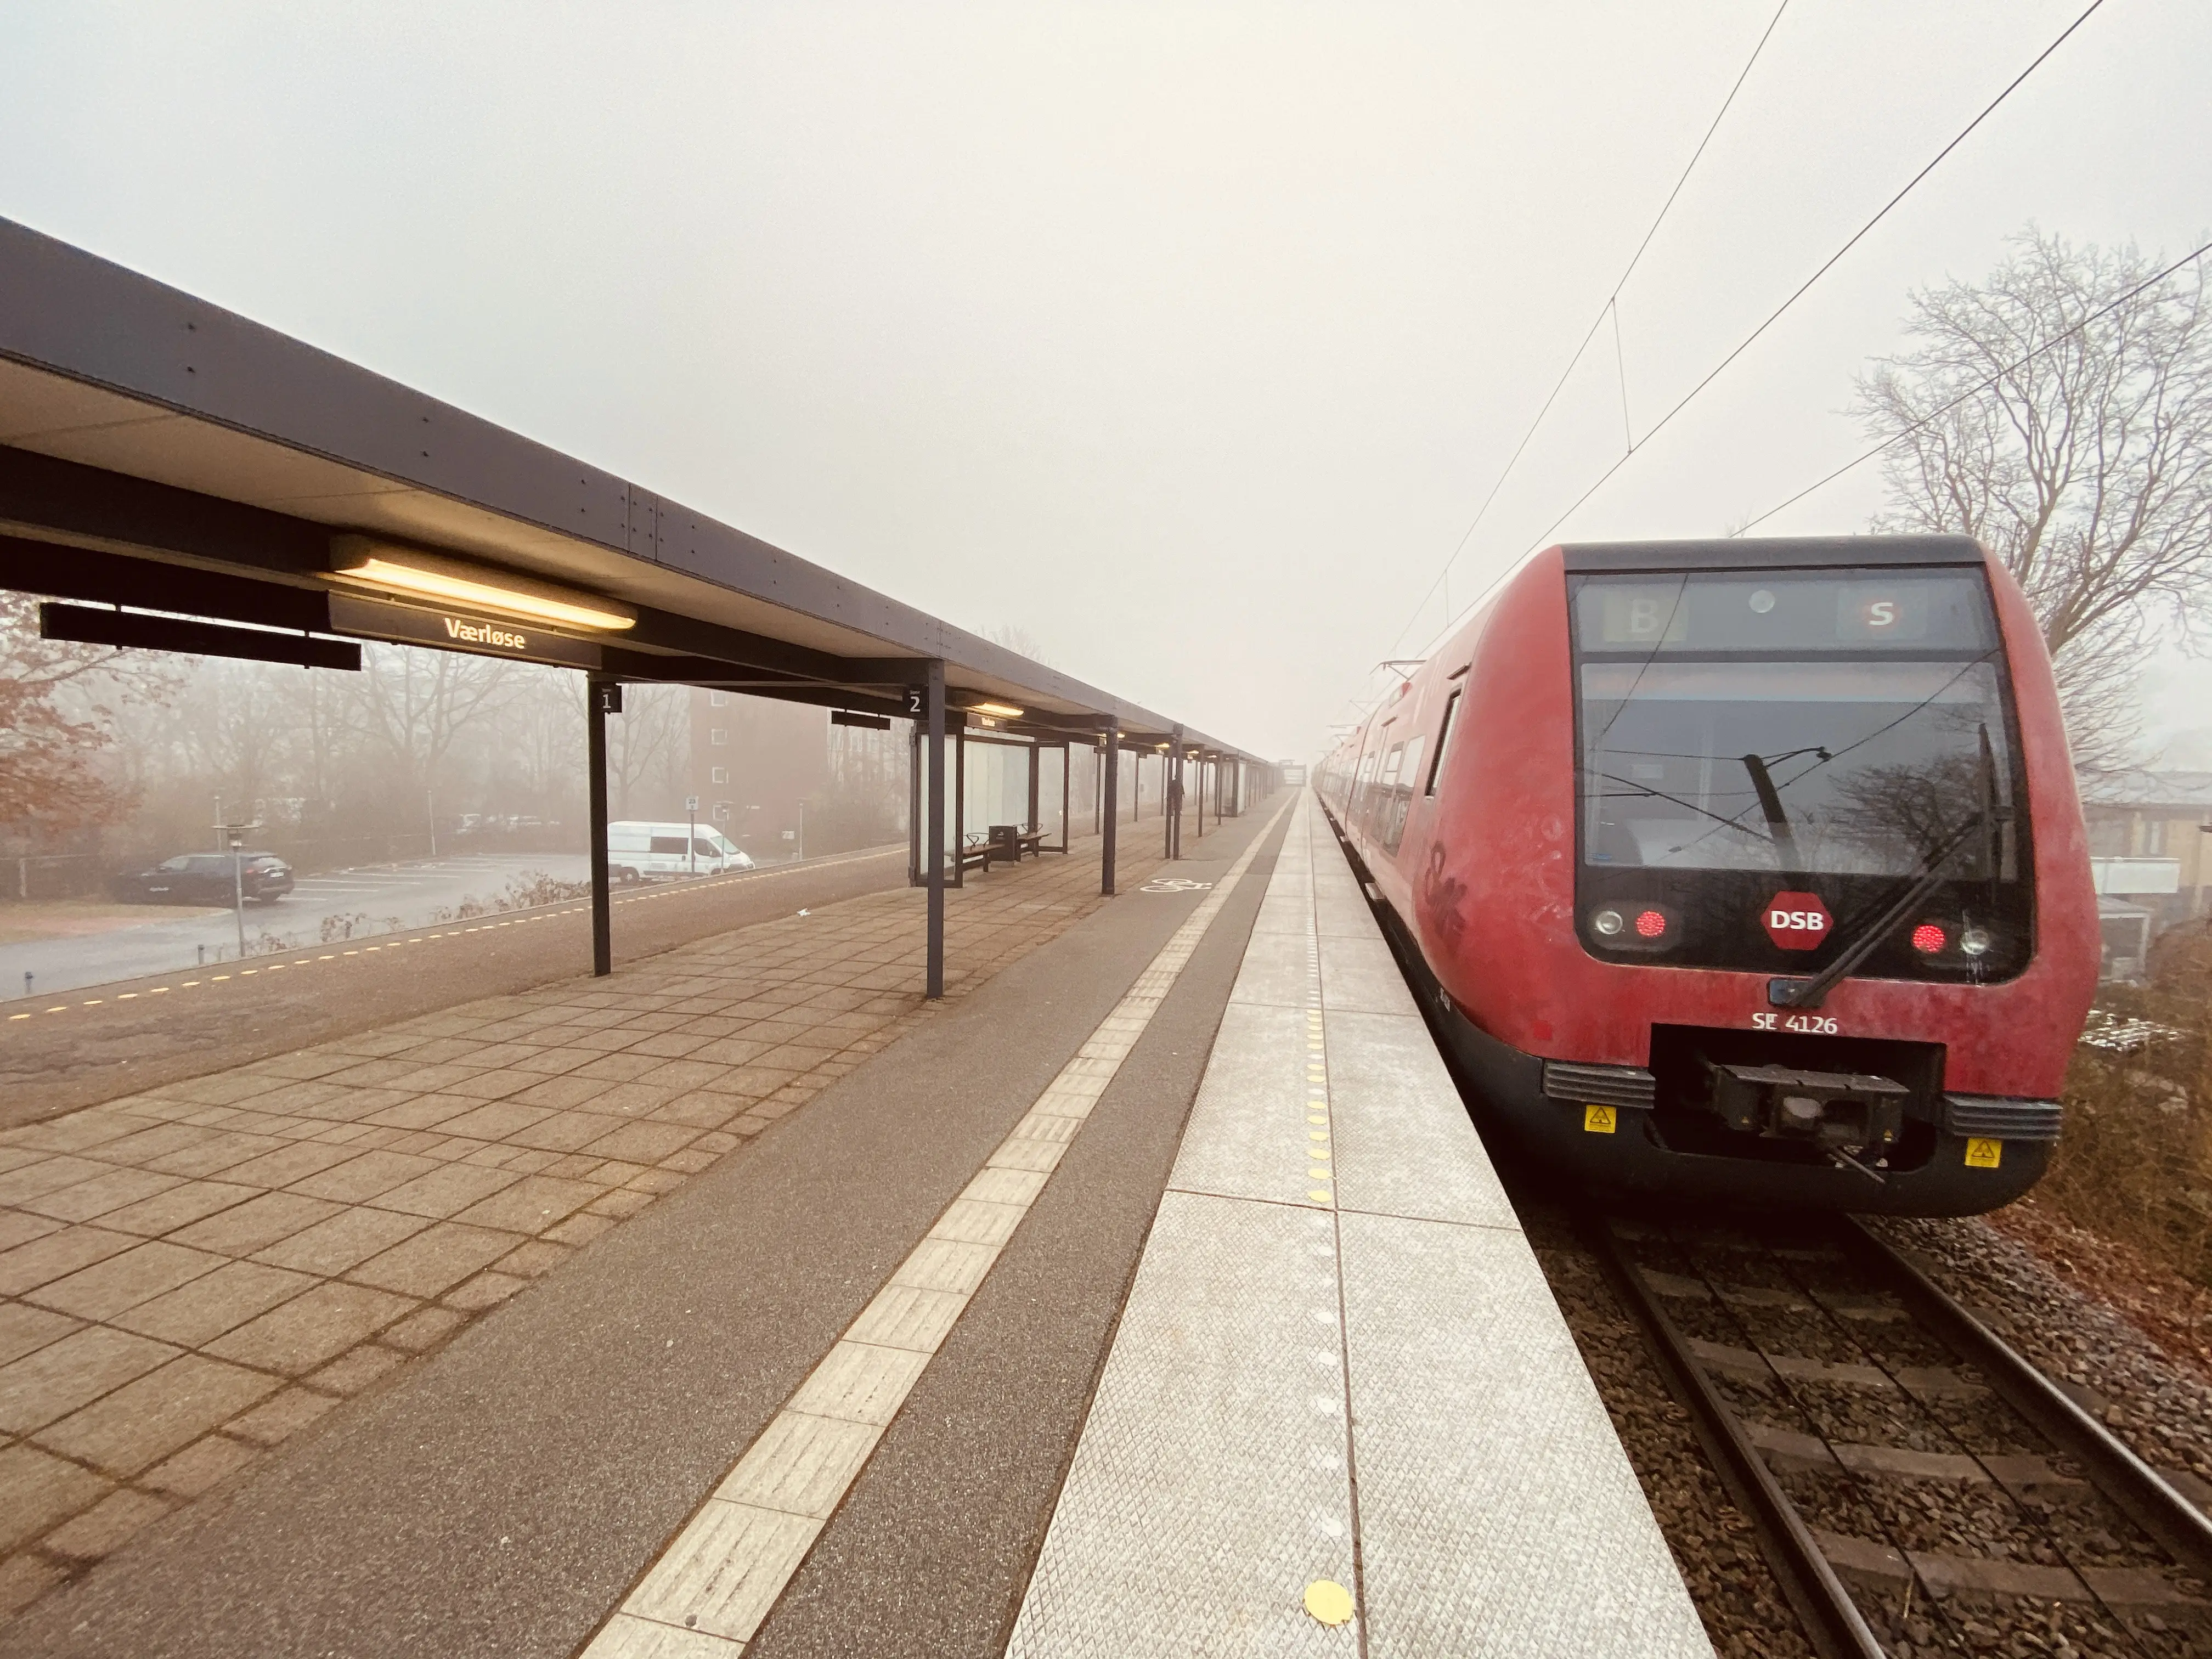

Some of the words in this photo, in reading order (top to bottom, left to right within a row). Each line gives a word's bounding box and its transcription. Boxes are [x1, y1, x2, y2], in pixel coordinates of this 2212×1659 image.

[1631, 599, 1658, 633] B
[444, 617, 525, 649] Værløse
[603, 694, 611, 709] 1
[910, 696, 921, 712] 2
[1771, 910, 1824, 930] DSB
[1752, 1012, 1778, 1030] SE
[1785, 1015, 1838, 1034] 4126
